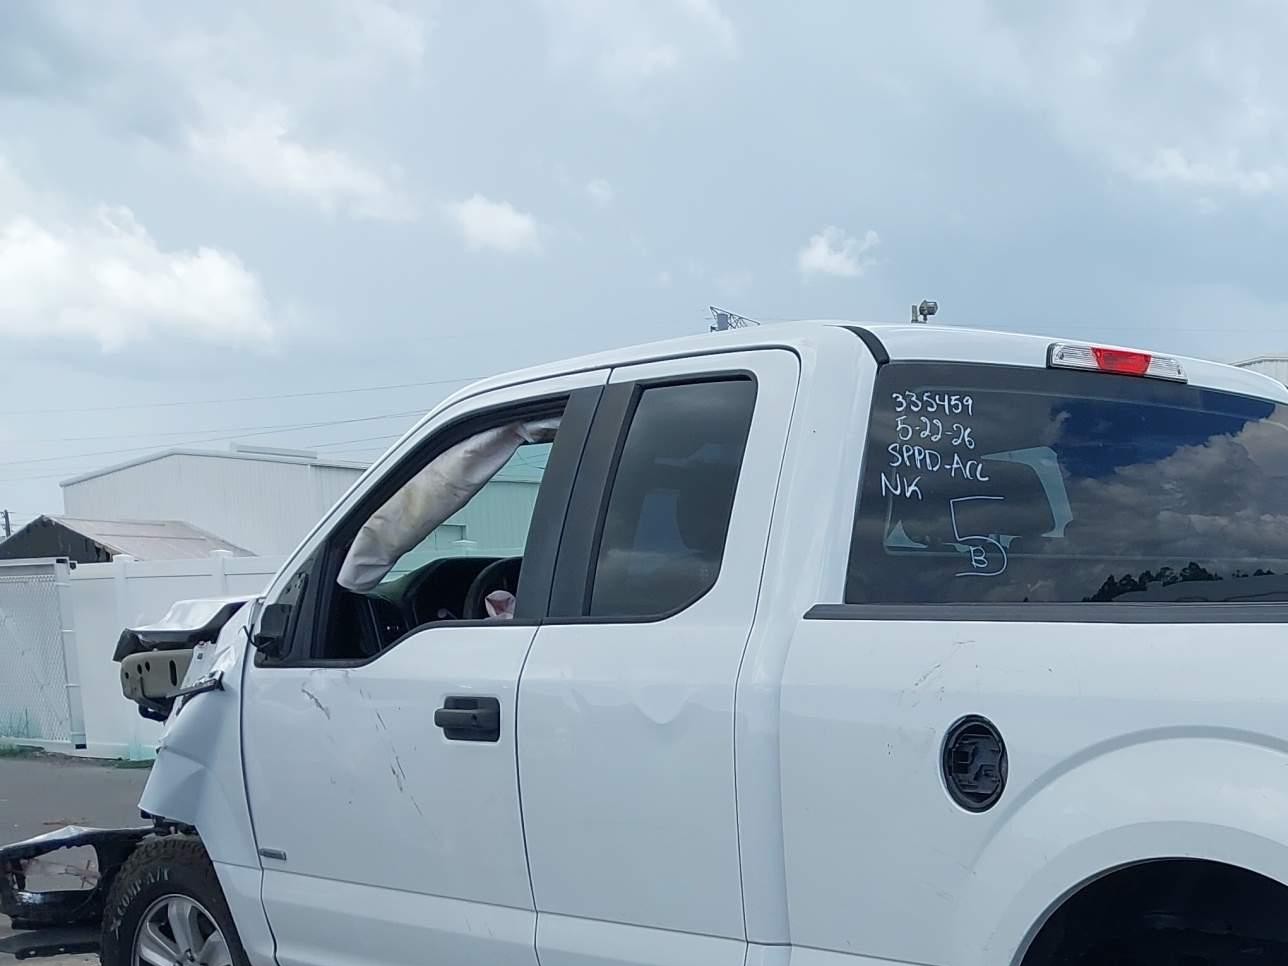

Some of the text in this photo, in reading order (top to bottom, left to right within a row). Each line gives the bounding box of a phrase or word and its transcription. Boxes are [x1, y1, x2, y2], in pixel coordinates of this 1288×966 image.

[892, 390, 974, 416] 335459
[896, 415, 975, 449] 5-22-26
[880, 472, 922, 500] NK
[969, 545, 988, 568] B
